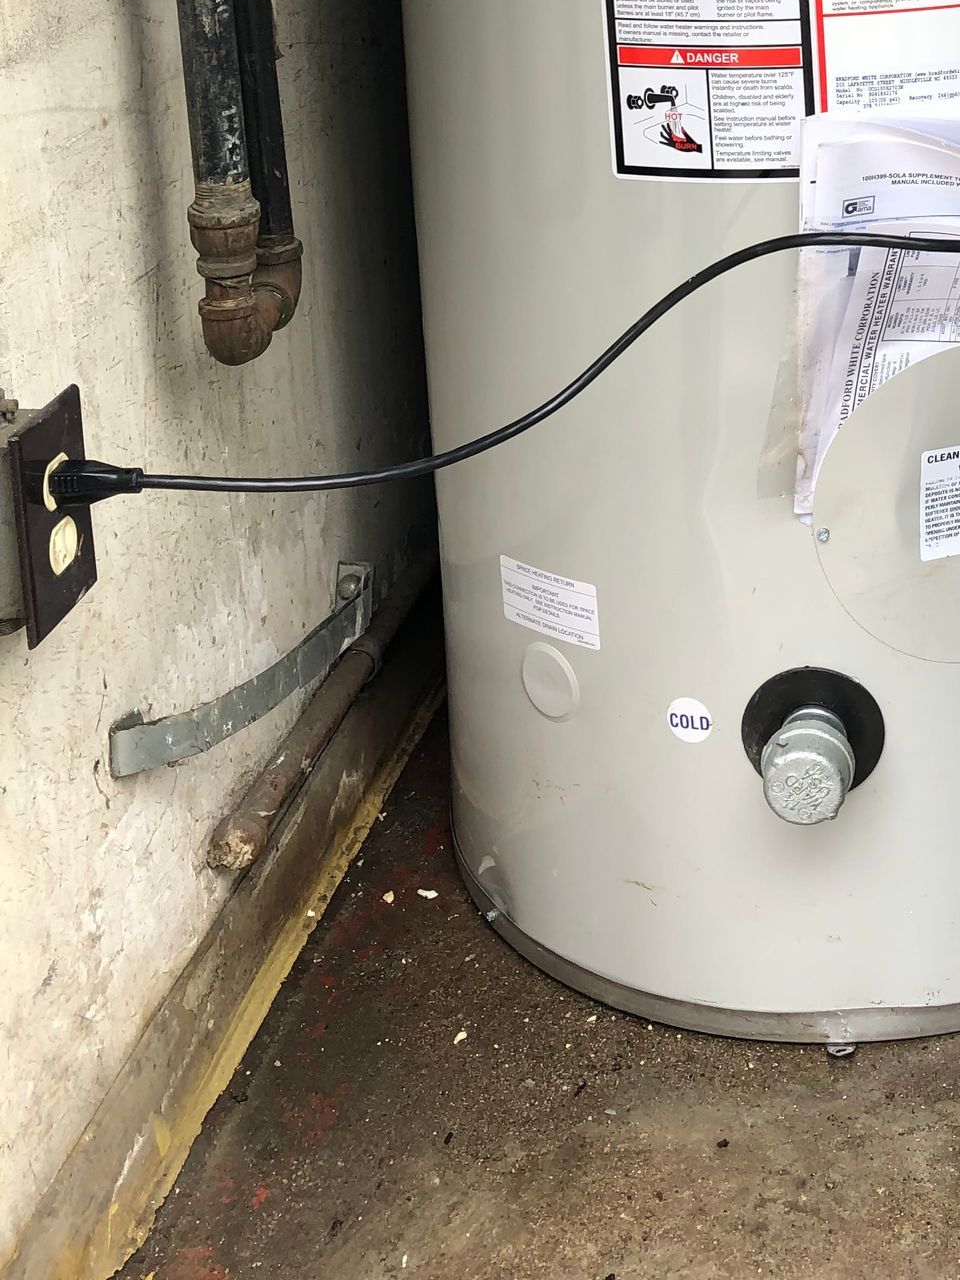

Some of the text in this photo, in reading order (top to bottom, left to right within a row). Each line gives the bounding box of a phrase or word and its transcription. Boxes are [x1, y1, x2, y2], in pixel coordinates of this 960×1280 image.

[687, 53, 739, 63] DANGER
[862, 173, 906, 182] 100H399-SOLA
[865, 326, 878, 361] WATER
[873, 293, 887, 325] HEATER
[883, 248, 899, 290] WARRAN
[846, 344, 861, 376] WHITE
[855, 272, 880, 341] CORPORATION
[532, 569, 552, 581] HEATING
[553, 577, 574, 588] RETURN
[532, 585, 559, 598] IMPORTANT
[516, 612, 583, 640] ALTERNATE DRAIN LOCATION
[669, 712, 711, 731] COLD
